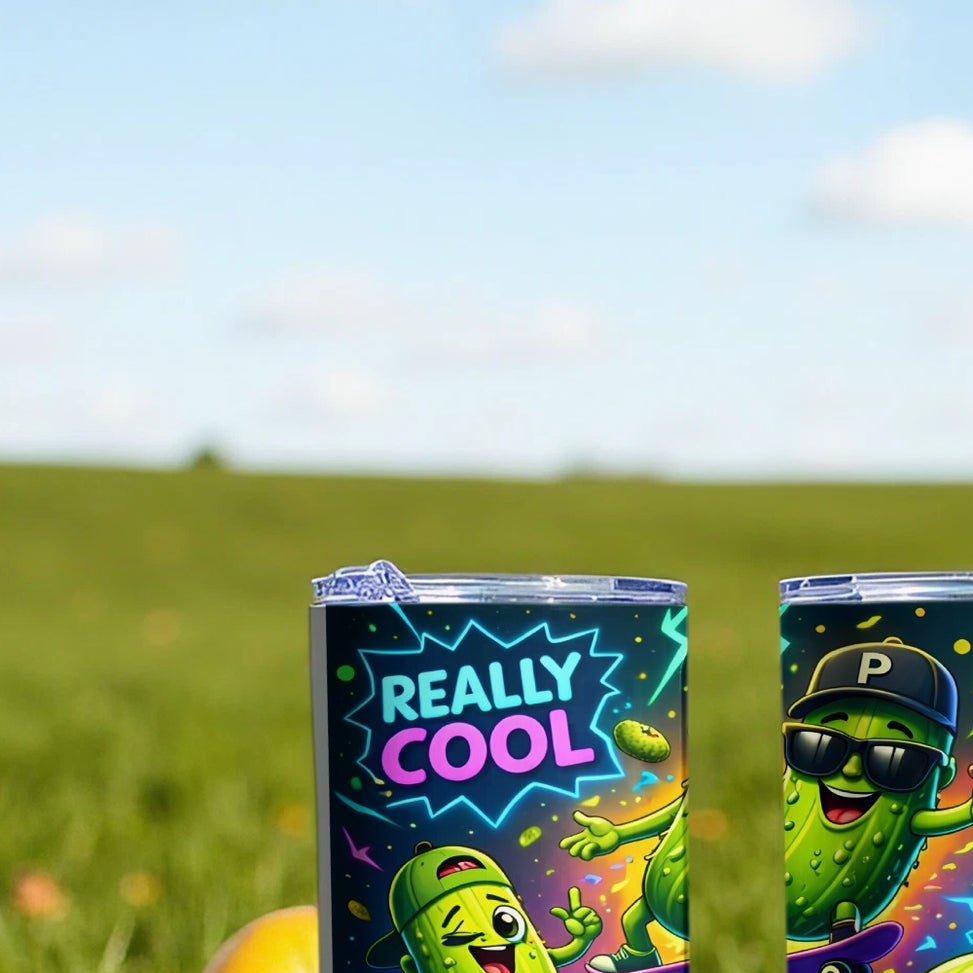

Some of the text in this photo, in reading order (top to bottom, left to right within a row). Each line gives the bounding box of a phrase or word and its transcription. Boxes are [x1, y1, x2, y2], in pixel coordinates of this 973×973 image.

[382, 652, 581, 723] REALLY
[856, 652, 892, 685] P
[381, 709, 595, 785] COOL
